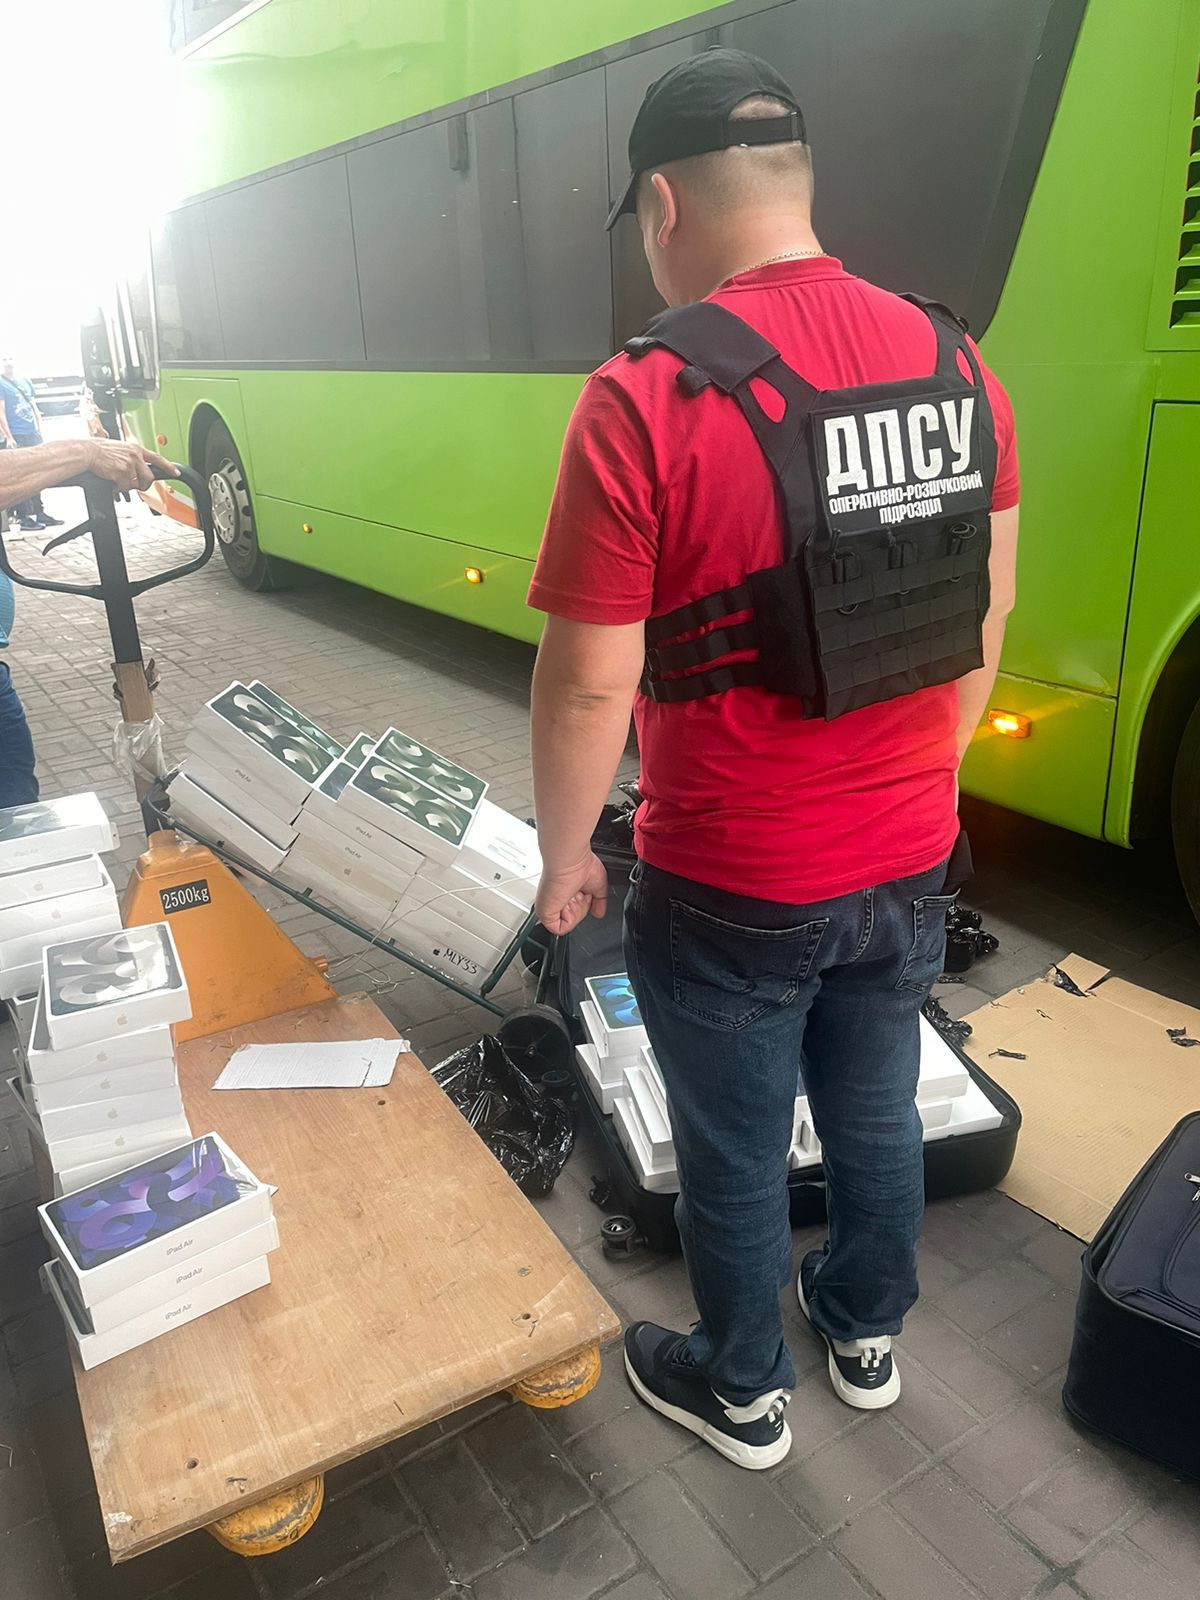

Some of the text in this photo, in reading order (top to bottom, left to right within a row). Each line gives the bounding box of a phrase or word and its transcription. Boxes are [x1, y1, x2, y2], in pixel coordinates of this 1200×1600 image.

[824, 398, 974, 496] ДПСУ
[829, 470, 983, 515] ОПЕРАТИВНО-РОЗШУКОВИЙ
[879, 498, 942, 524] ПІДРОЗДІЛ
[162, 886, 210, 910] 2500kg
[166, 1239, 194, 1256] iPad Air
[176, 1267, 203, 1284] iPad Air
[165, 1303, 192, 1320] iPad Air
